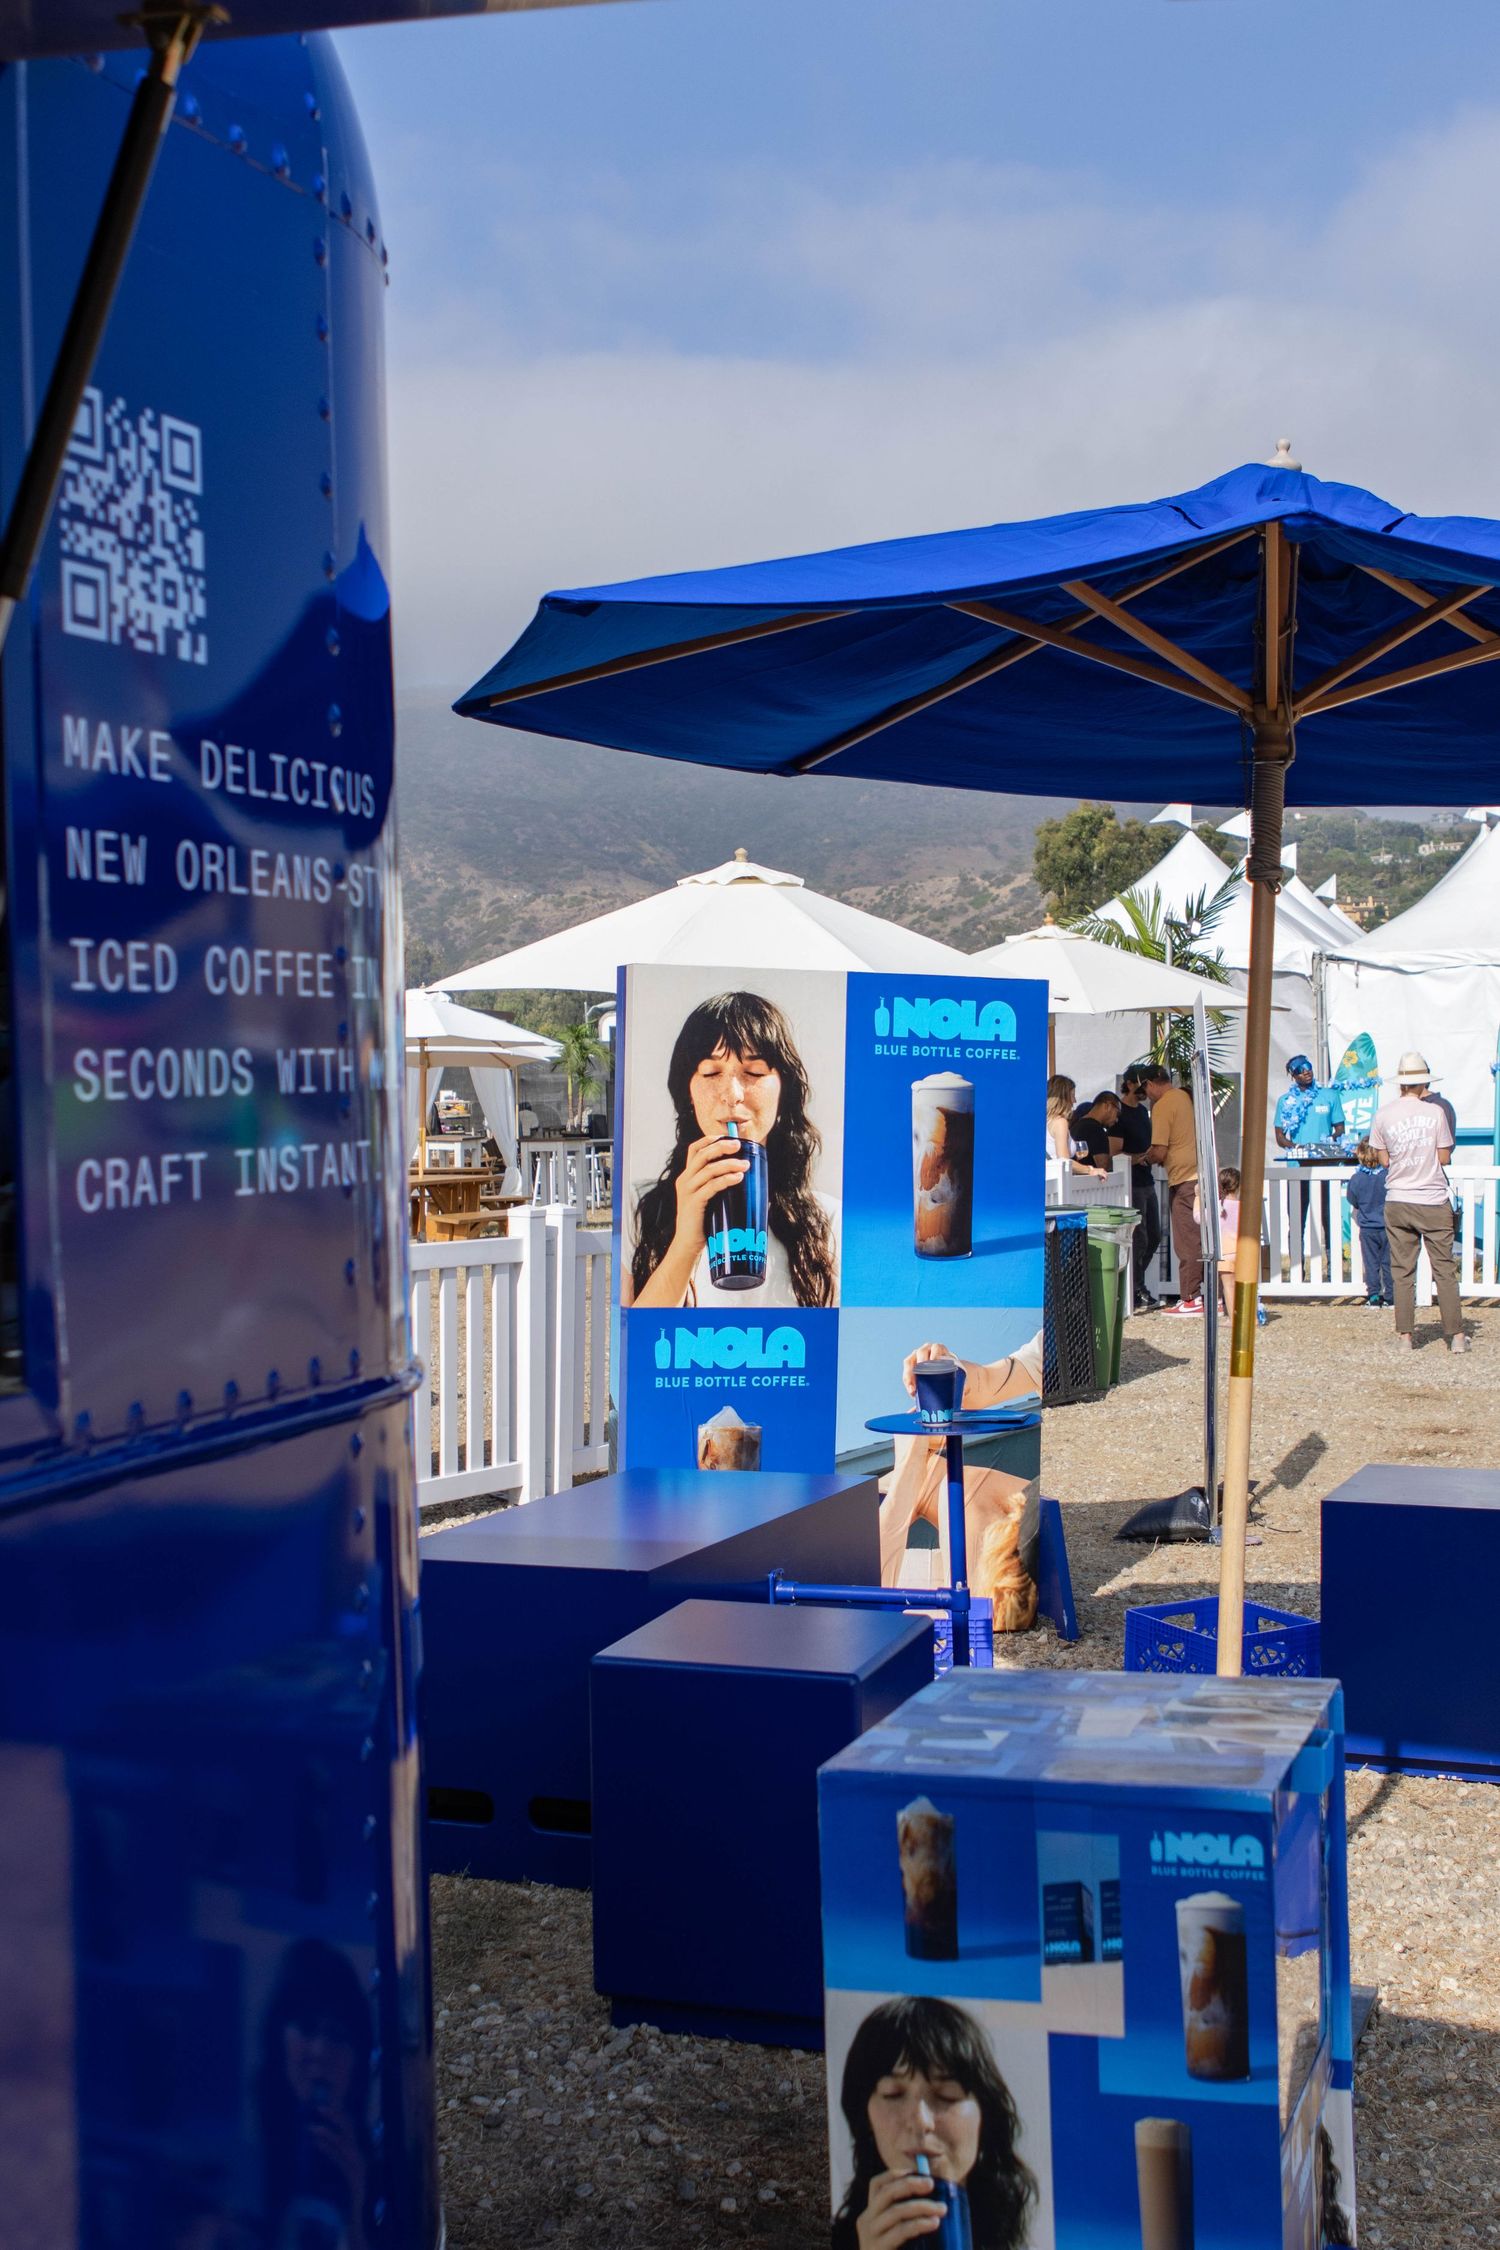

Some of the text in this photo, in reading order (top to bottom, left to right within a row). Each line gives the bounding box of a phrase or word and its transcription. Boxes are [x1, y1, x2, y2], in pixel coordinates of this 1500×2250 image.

[63, 715, 375, 819] MAKE DELICIOUS
[66, 827, 147, 885] NEW
[69, 938, 177, 993] ICED
[204, 945, 334, 999] COFFEE
[893, 997, 1016, 1042] NOLA
[875, 1044, 907, 1056] BLUE
[912, 1046, 961, 1058] BOTTLE
[74, 1047, 254, 1102] SECONDS
[277, 1048, 354, 1093] WITH
[1386, 1115, 1437, 1137] MALIBU
[76, 1151, 207, 1213] CRAFT
[708, 1228, 768, 1259] NOLA
[675, 1326, 805, 1369] NOLA
[655, 1377, 689, 1388] BLUE
[695, 1376, 746, 1387] BOTTLE
[1164, 1831, 1264, 1867] NOLA
[1152, 1865, 1177, 1876] BLUE
[1181, 1867, 1219, 1879] BOTTLE
